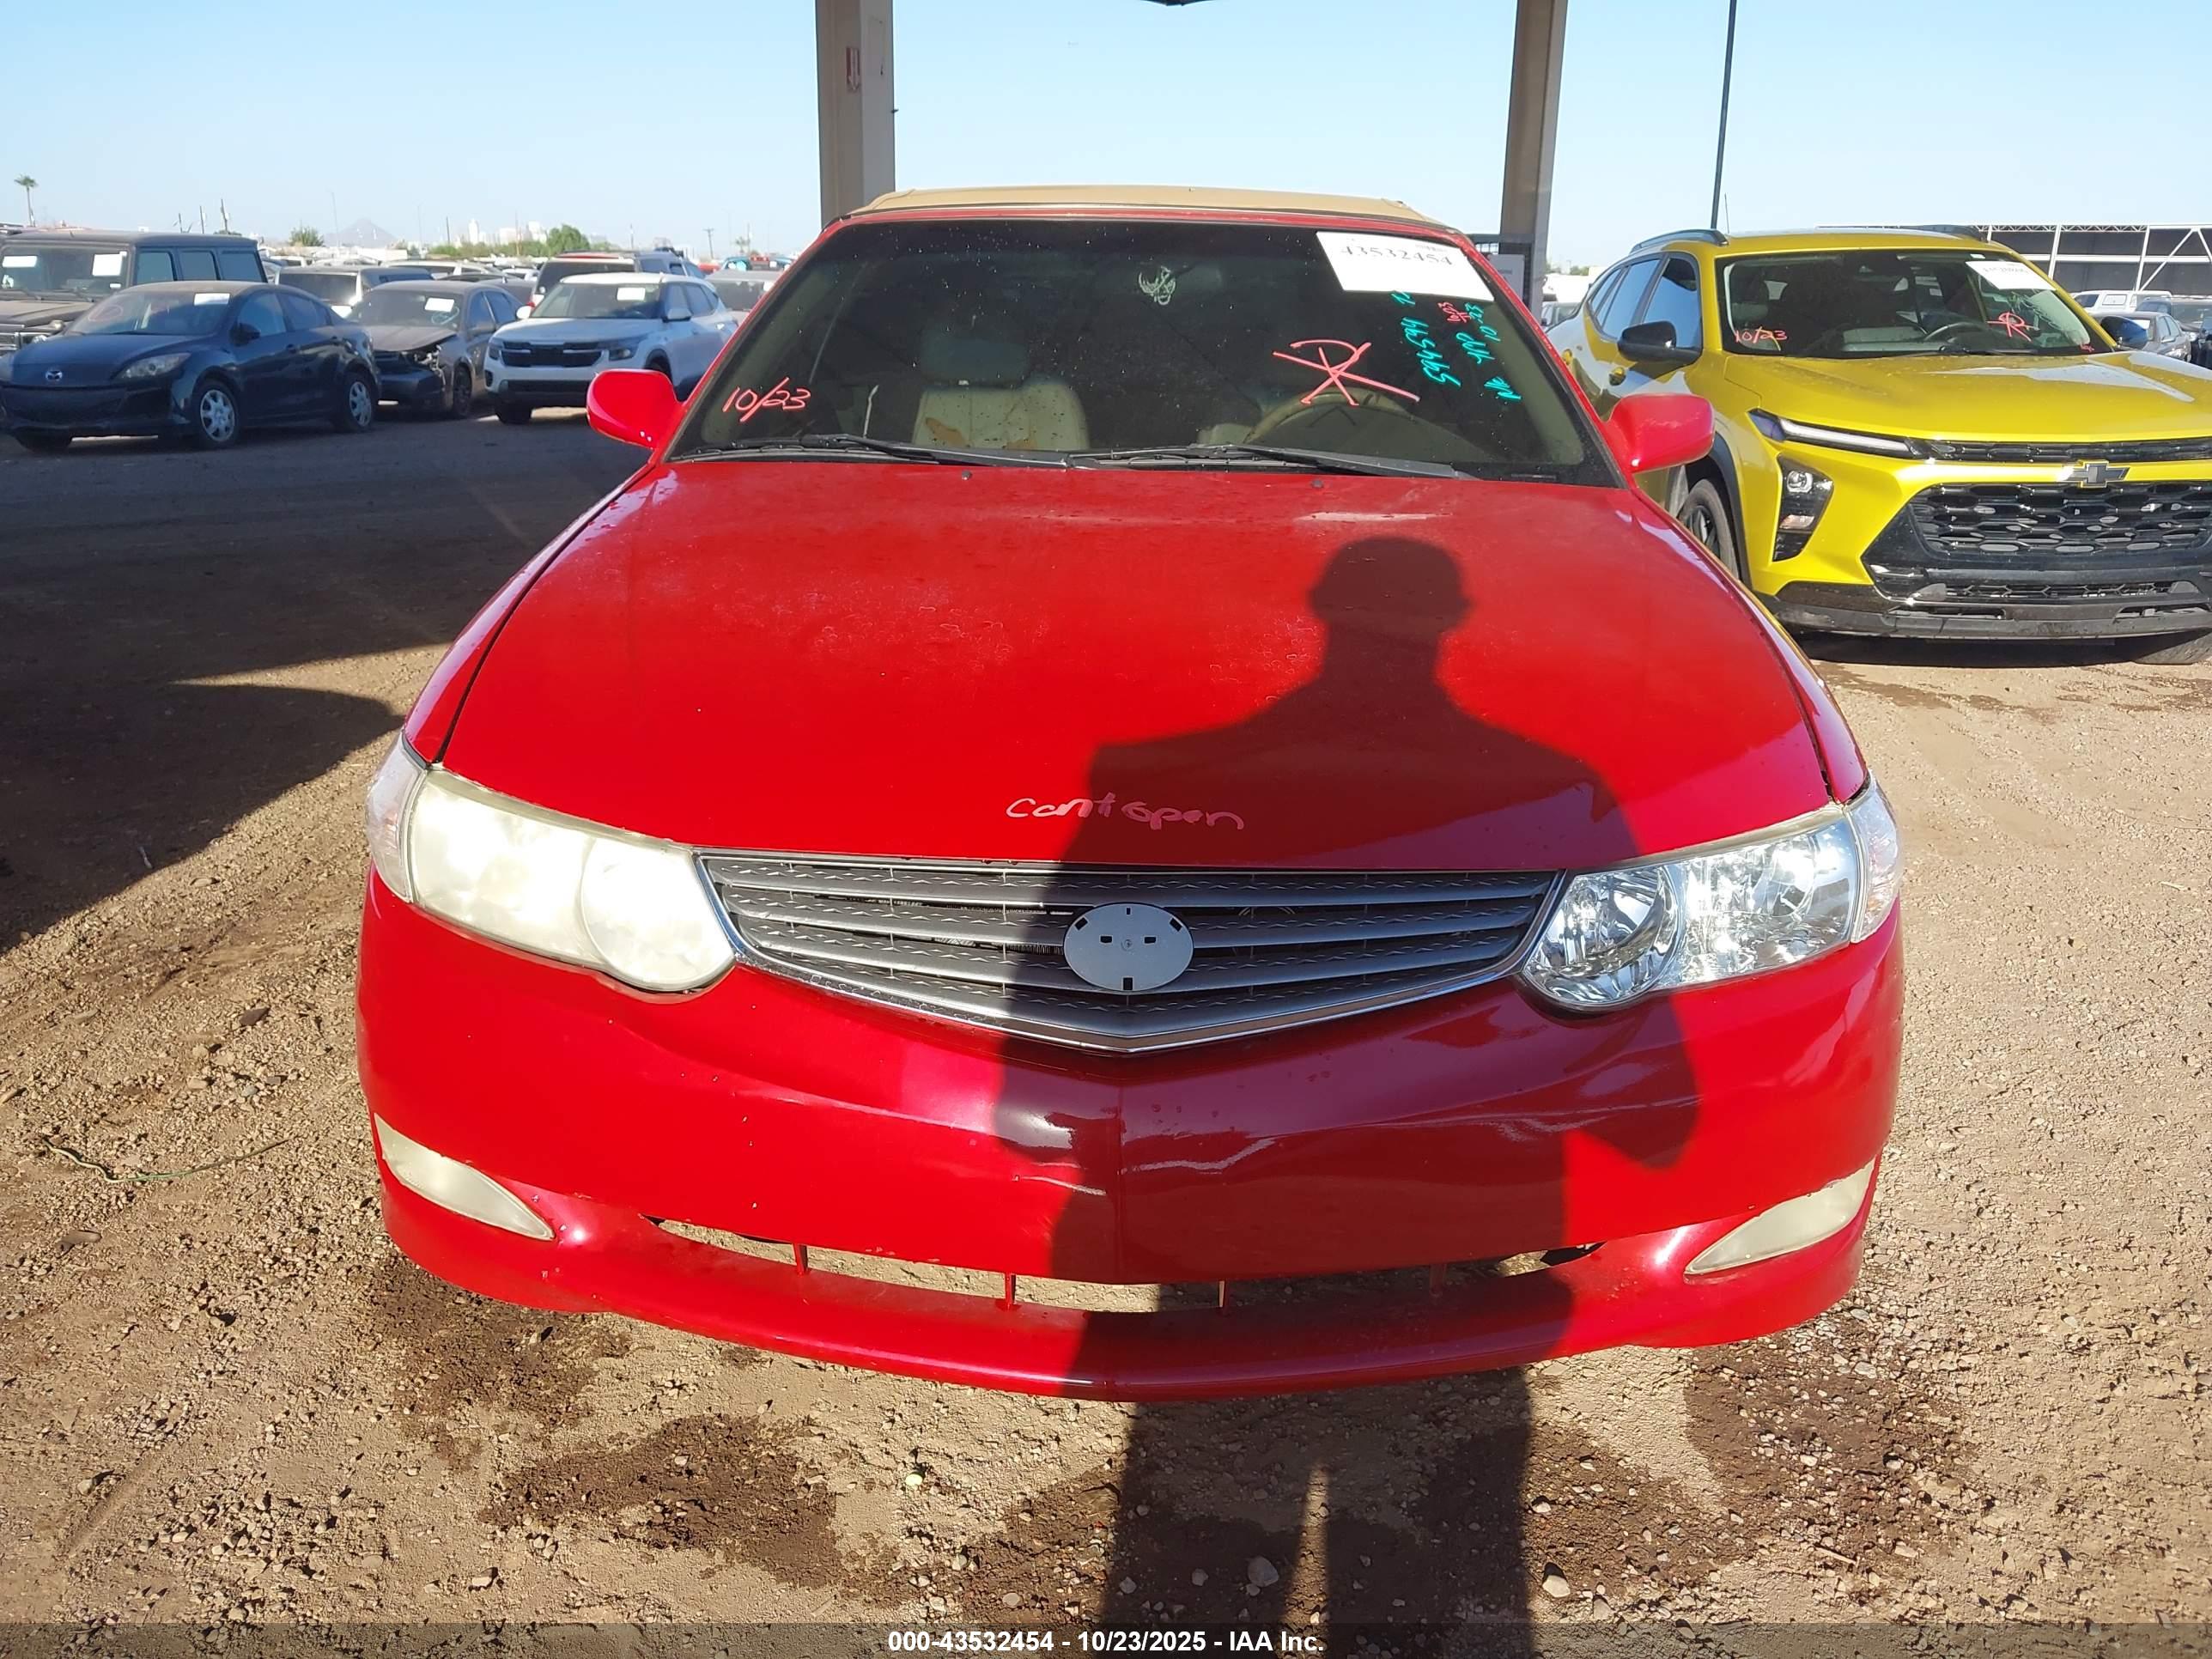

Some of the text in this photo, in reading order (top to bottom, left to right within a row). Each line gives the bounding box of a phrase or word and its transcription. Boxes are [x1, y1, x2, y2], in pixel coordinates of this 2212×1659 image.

[1340, 245, 1453, 265] 43532454
[1735, 326, 1787, 343] 10/23
[721, 377, 811, 422] 10/23
